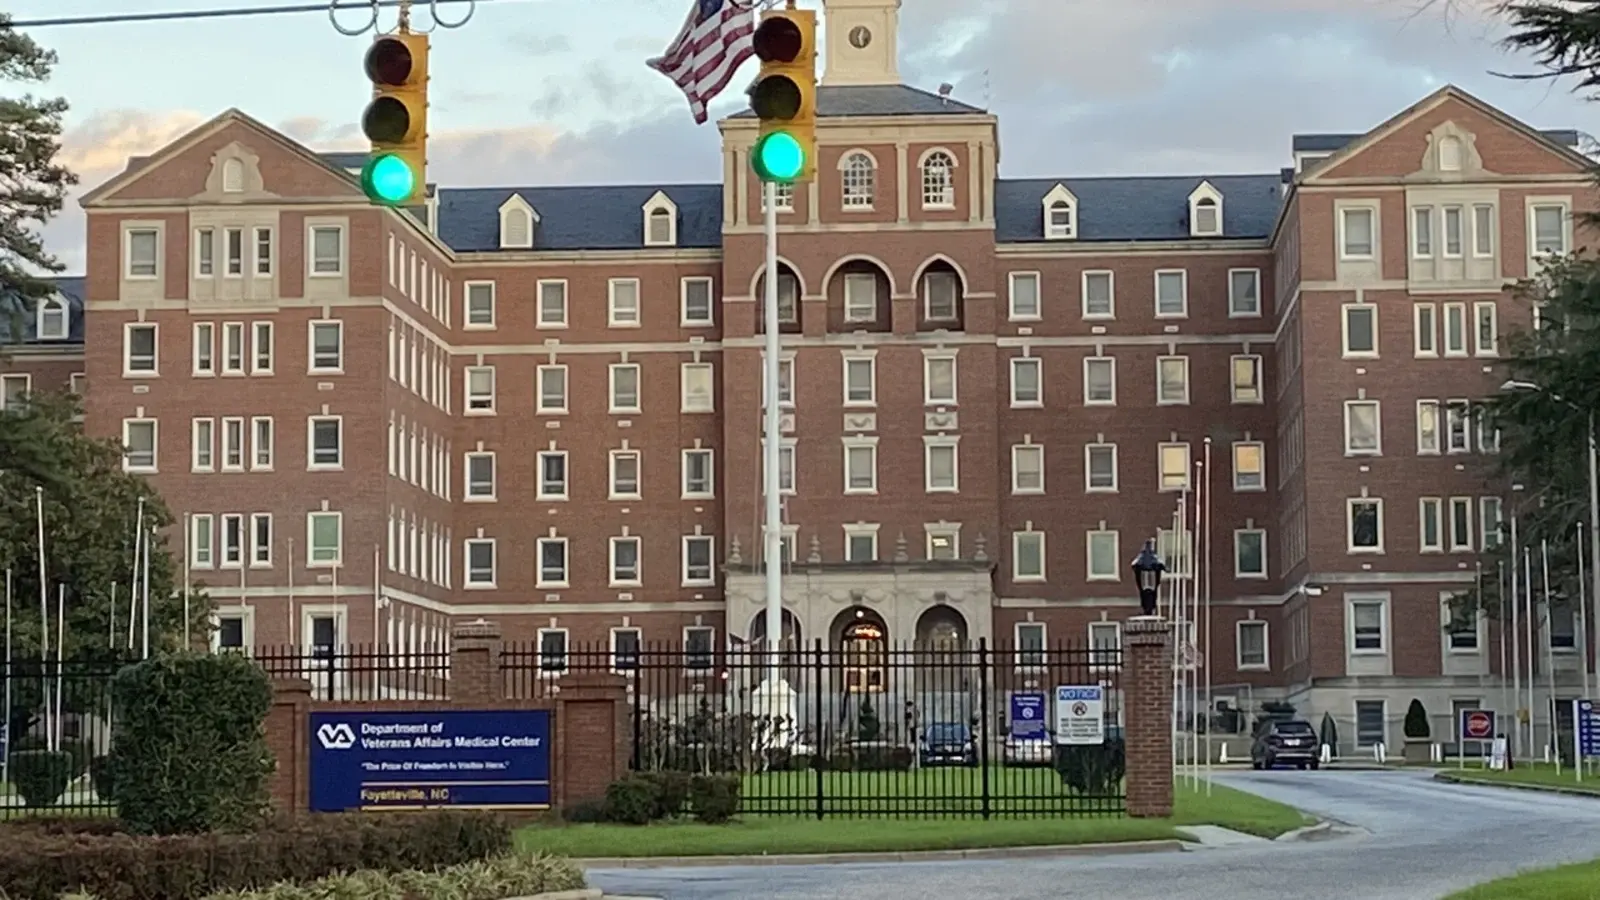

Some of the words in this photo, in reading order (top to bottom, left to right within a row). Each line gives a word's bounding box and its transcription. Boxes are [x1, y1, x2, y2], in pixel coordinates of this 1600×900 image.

[1060, 689, 1098, 699] NOTICE
[319, 726, 353, 746] VA
[361, 723, 428, 736] Department
[430, 722, 444, 734] of
[361, 737, 412, 749] Veterans
[413, 736, 452, 748] Affairs
[454, 736, 500, 748] Medical
[501, 735, 541, 747] Center
[361, 788, 428, 803] Fayetteville,
[430, 788, 450, 800] NC
